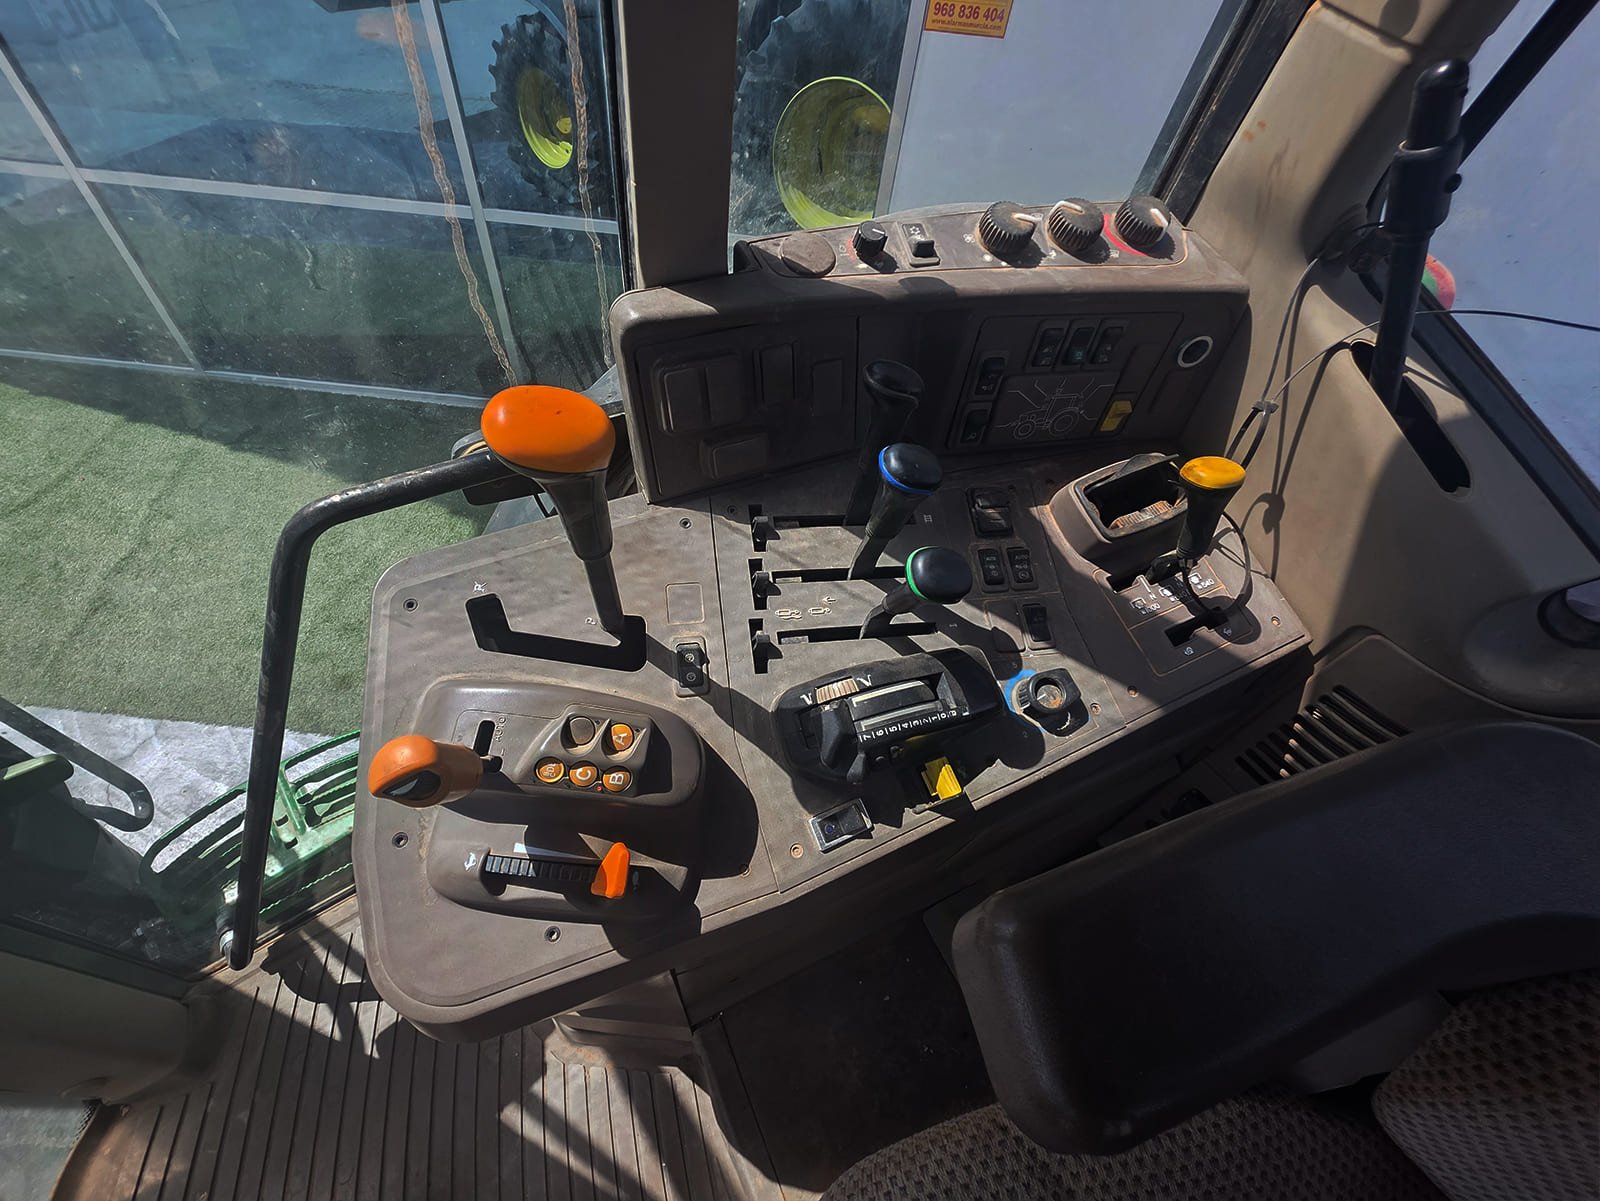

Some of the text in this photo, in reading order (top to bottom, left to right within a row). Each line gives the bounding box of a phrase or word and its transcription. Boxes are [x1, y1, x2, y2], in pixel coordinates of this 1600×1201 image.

[934, 2, 1006, 22] 968 836 404
[612, 733, 627, 745] A
[576, 768, 591, 781] C
[609, 773, 624, 785] B
